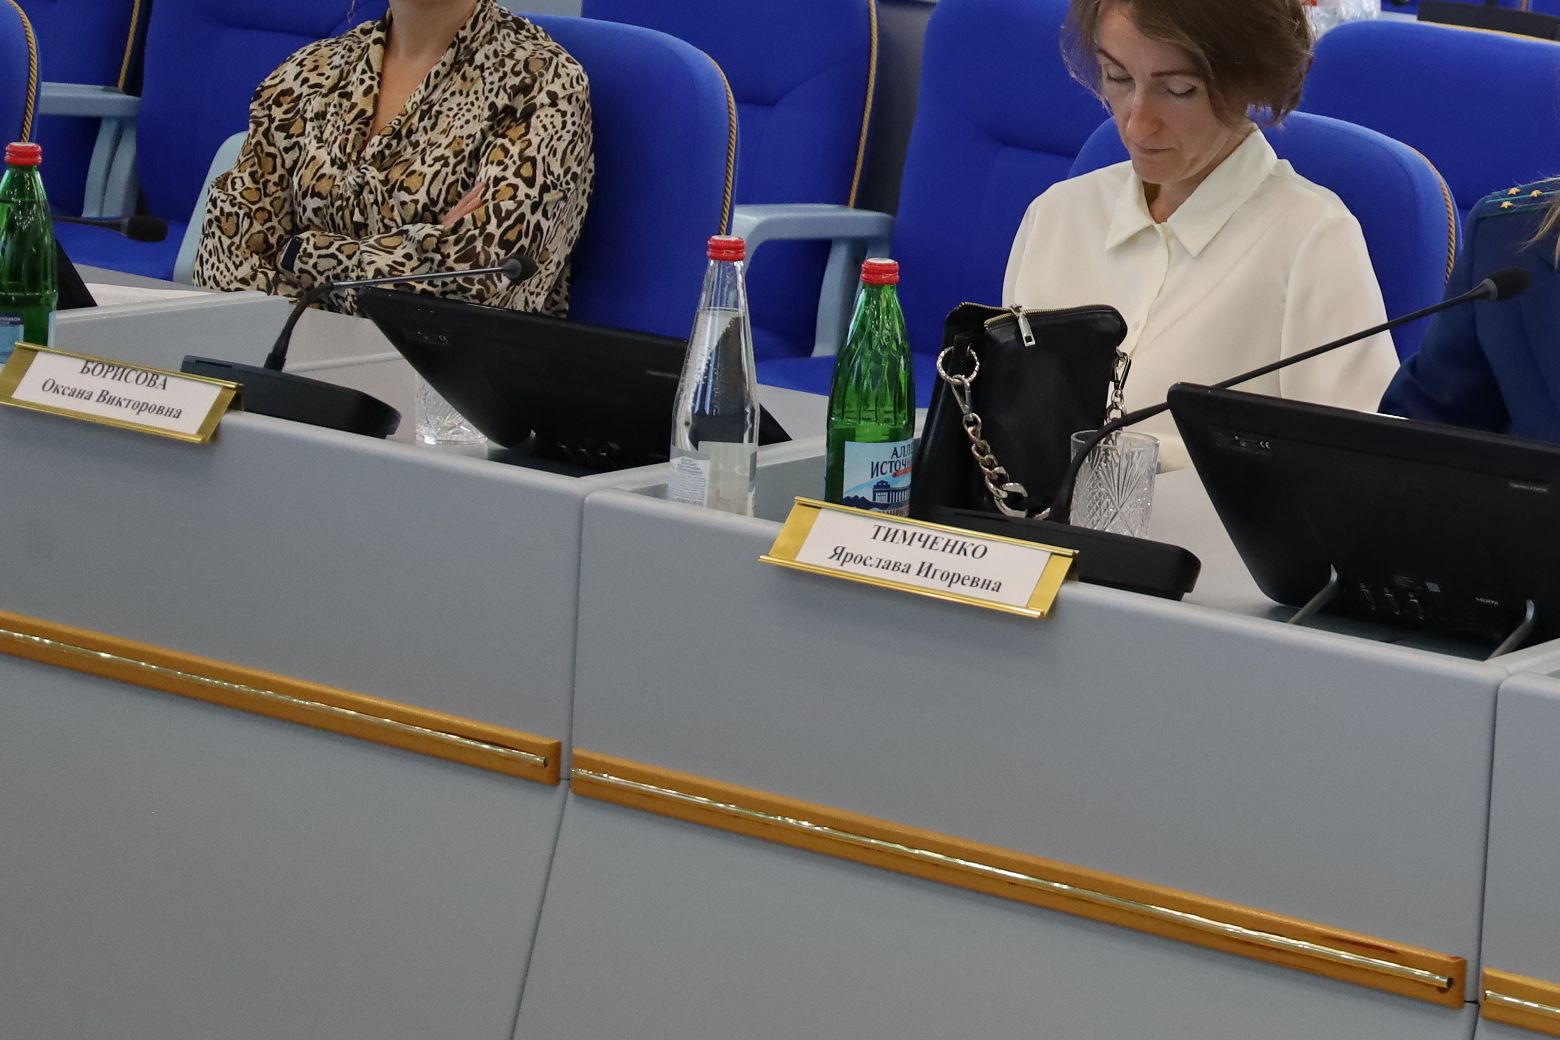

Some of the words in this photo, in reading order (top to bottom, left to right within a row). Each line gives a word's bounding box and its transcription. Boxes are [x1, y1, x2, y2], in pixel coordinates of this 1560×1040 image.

[80, 360, 168, 391] БОРИСОВА
[41, 378, 93, 401] Оксана
[96, 390, 182, 420] Викторовна
[890, 443, 913, 459] АЛЛ
[871, 524, 988, 560] ТИМЧЕНКО
[828, 545, 911, 574] Ярослава
[915, 561, 1002, 593] Игоревна
